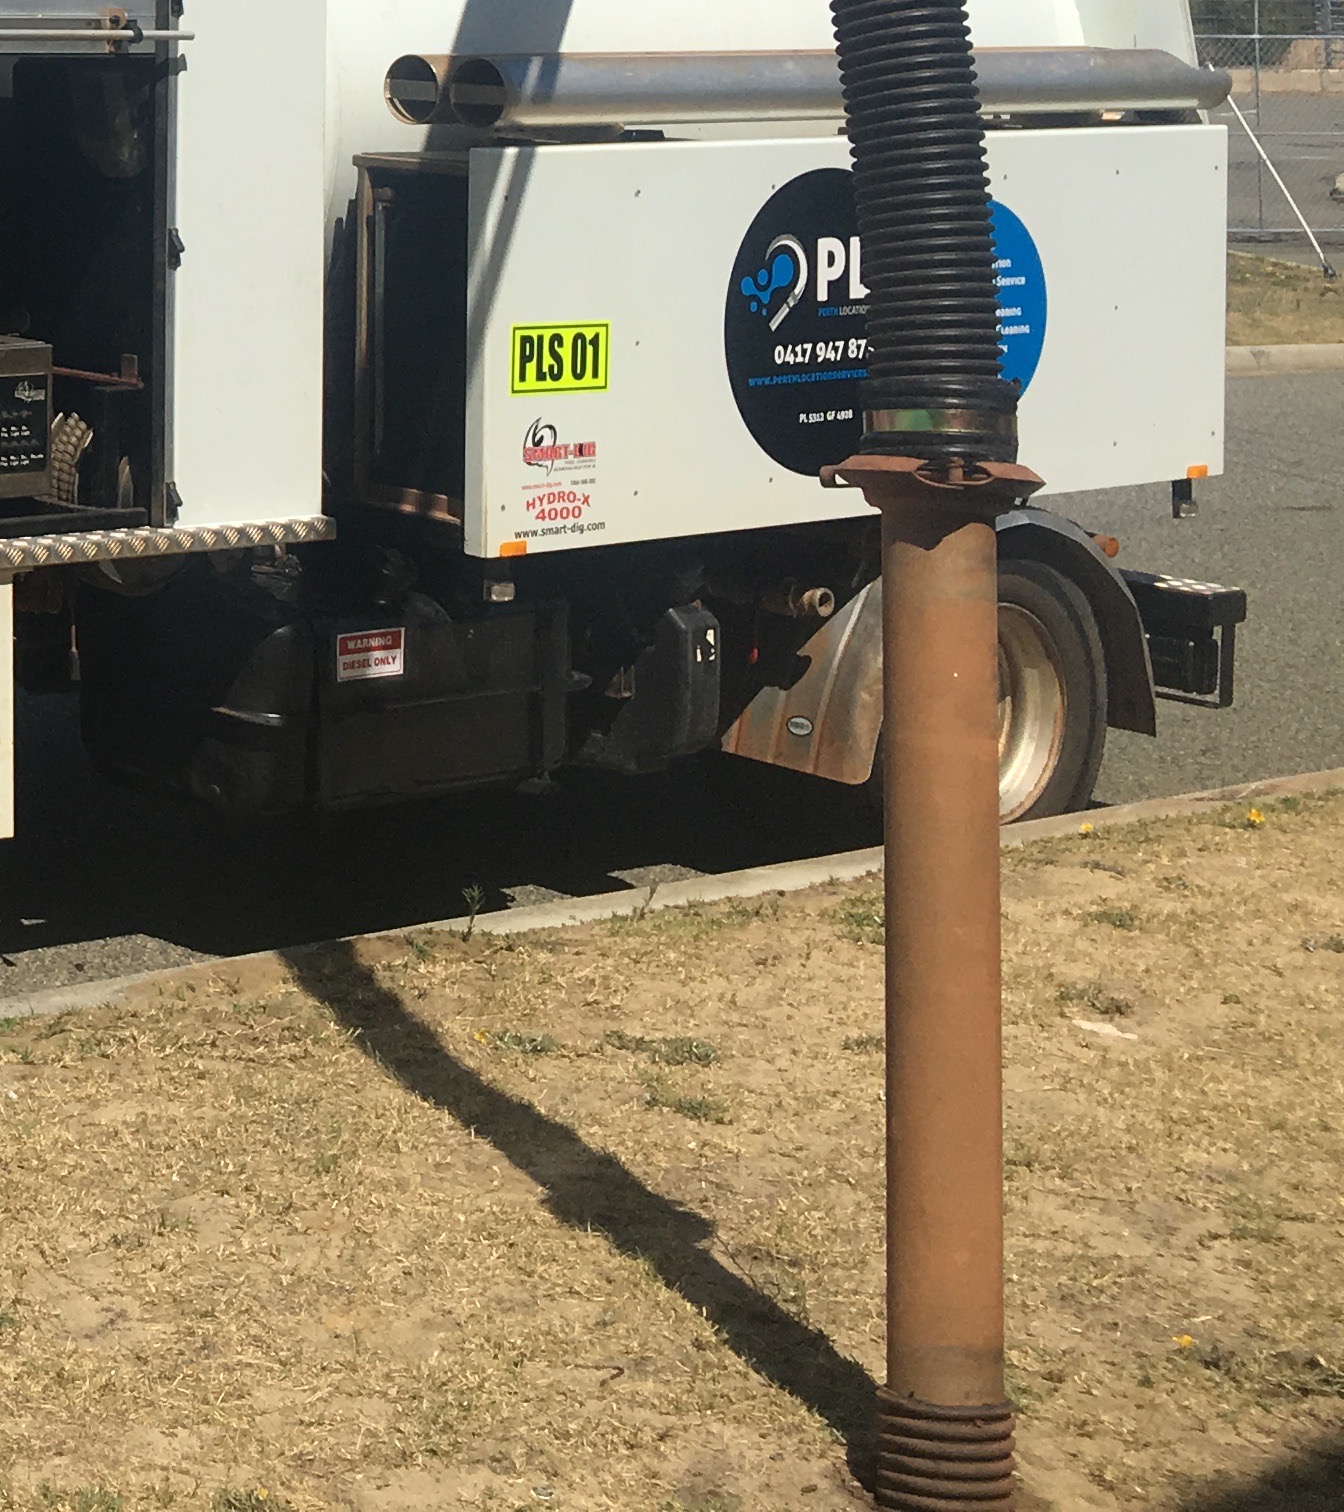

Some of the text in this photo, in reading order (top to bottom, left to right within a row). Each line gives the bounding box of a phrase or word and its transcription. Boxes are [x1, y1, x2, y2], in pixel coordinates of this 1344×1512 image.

[816, 236, 871, 302] PL
[519, 332, 600, 383] PLS 01
[774, 338, 875, 365] 0417 947 87
[799, 414, 808, 423] PL
[526, 490, 591, 512] HYDRO-X
[535, 505, 583, 522] 4000
[514, 521, 606, 540] www.smart-dig.com
[347, 635, 393, 650] WARNING
[342, 655, 397, 671] DIESEL ONLY
